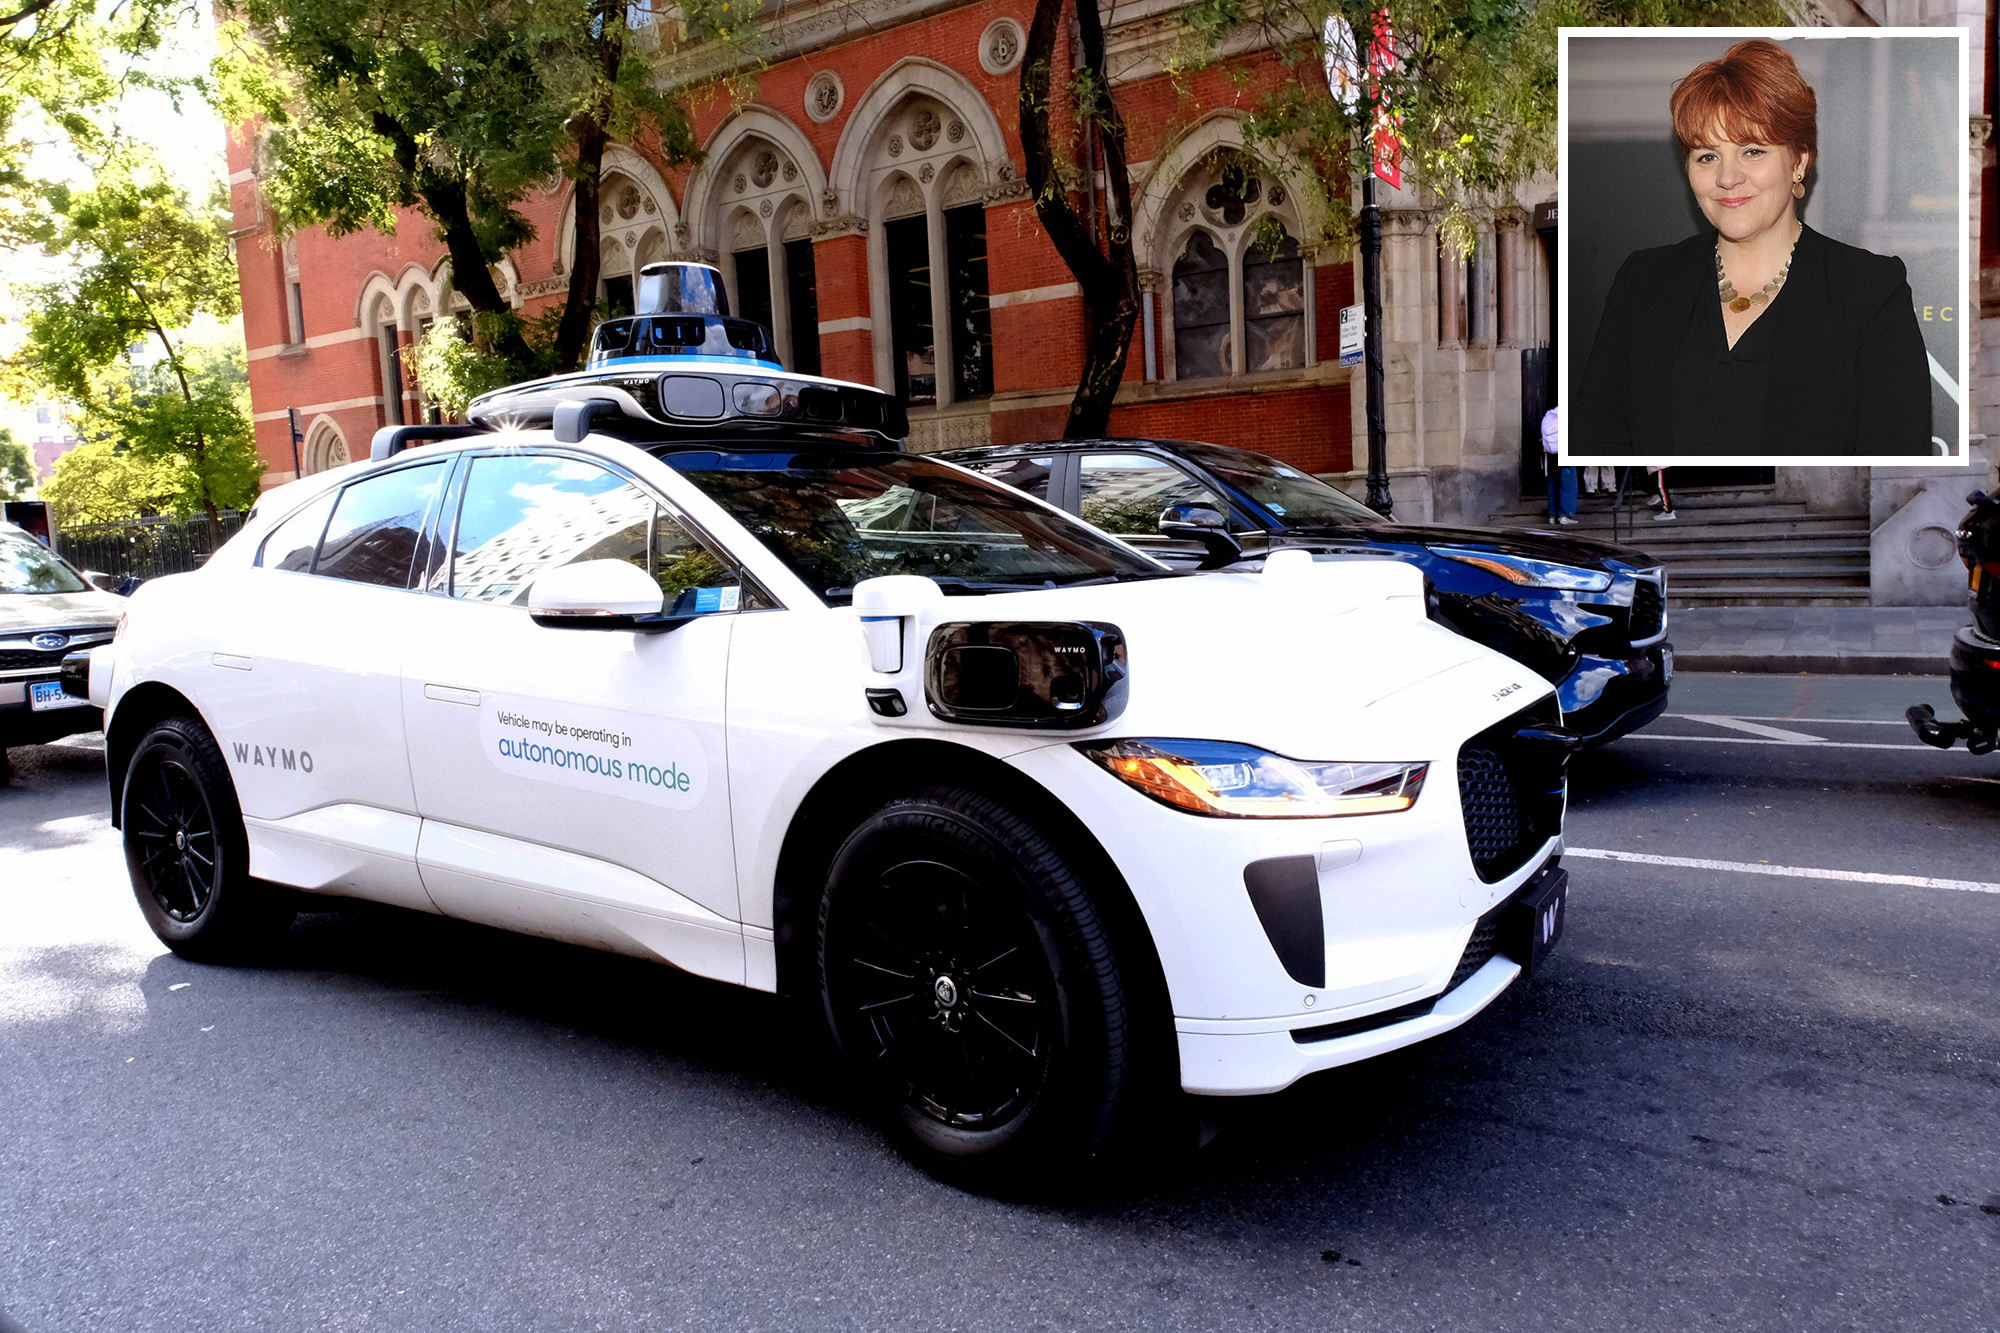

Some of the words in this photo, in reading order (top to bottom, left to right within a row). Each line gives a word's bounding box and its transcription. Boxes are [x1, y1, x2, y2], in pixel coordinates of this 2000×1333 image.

[1341, 310, 1347, 323] 2
[1914, 306, 1953, 322] EC
[497, 711, 530, 729] Vehicle
[531, 719, 553, 736] may
[555, 720, 568, 735] be
[569, 726, 620, 749] operating
[621, 732, 632, 747] in
[232, 741, 314, 773] WAYMO
[498, 737, 623, 779] autonomous
[628, 762, 690, 792] mode
